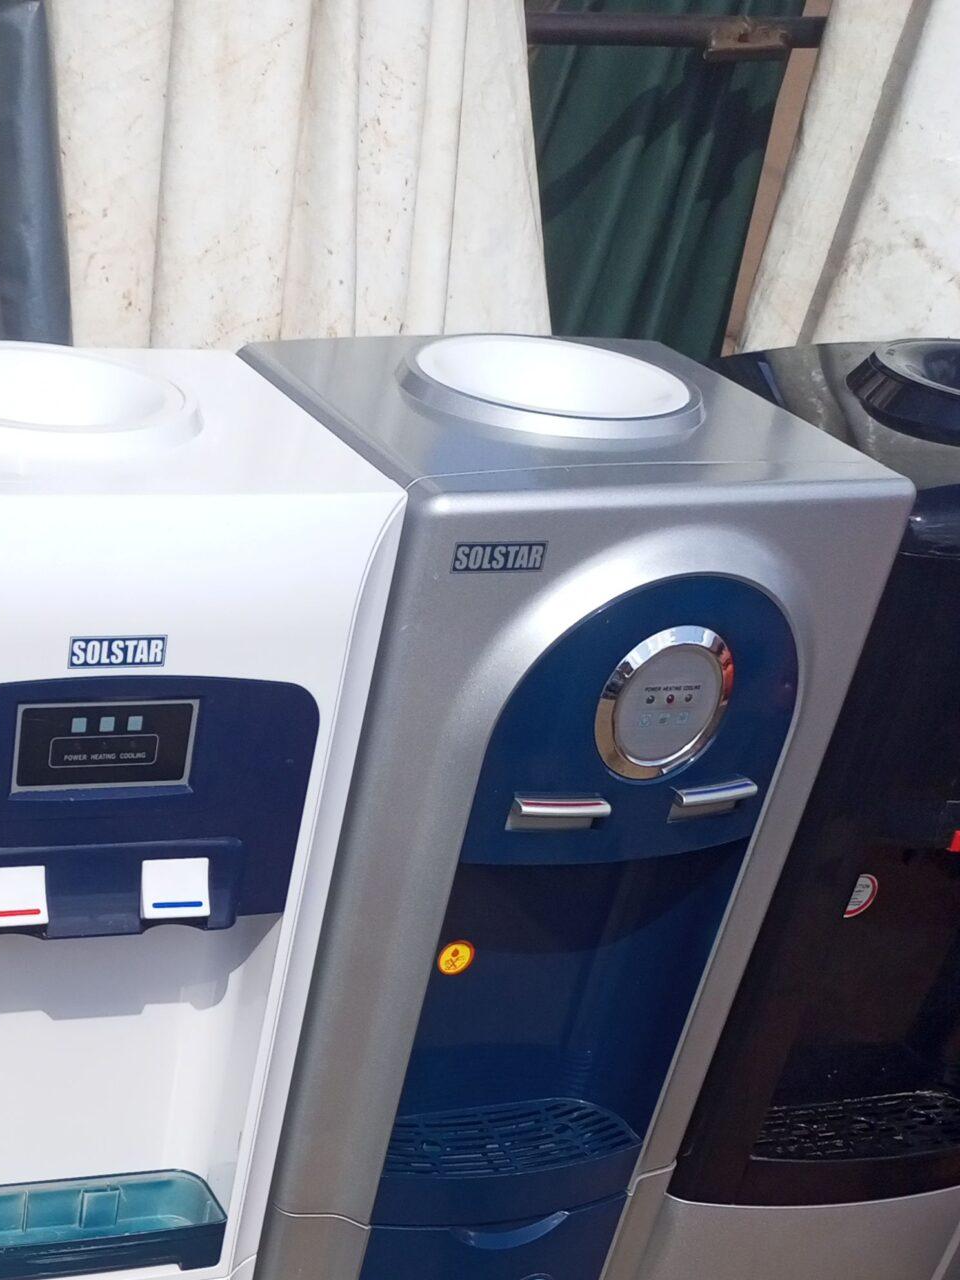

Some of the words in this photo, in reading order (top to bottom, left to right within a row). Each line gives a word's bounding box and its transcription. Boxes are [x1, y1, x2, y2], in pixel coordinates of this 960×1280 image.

[454, 546, 543, 570] SOLSTAR
[70, 639, 164, 666] SOLSTAR
[119, 751, 146, 759] COOLING
